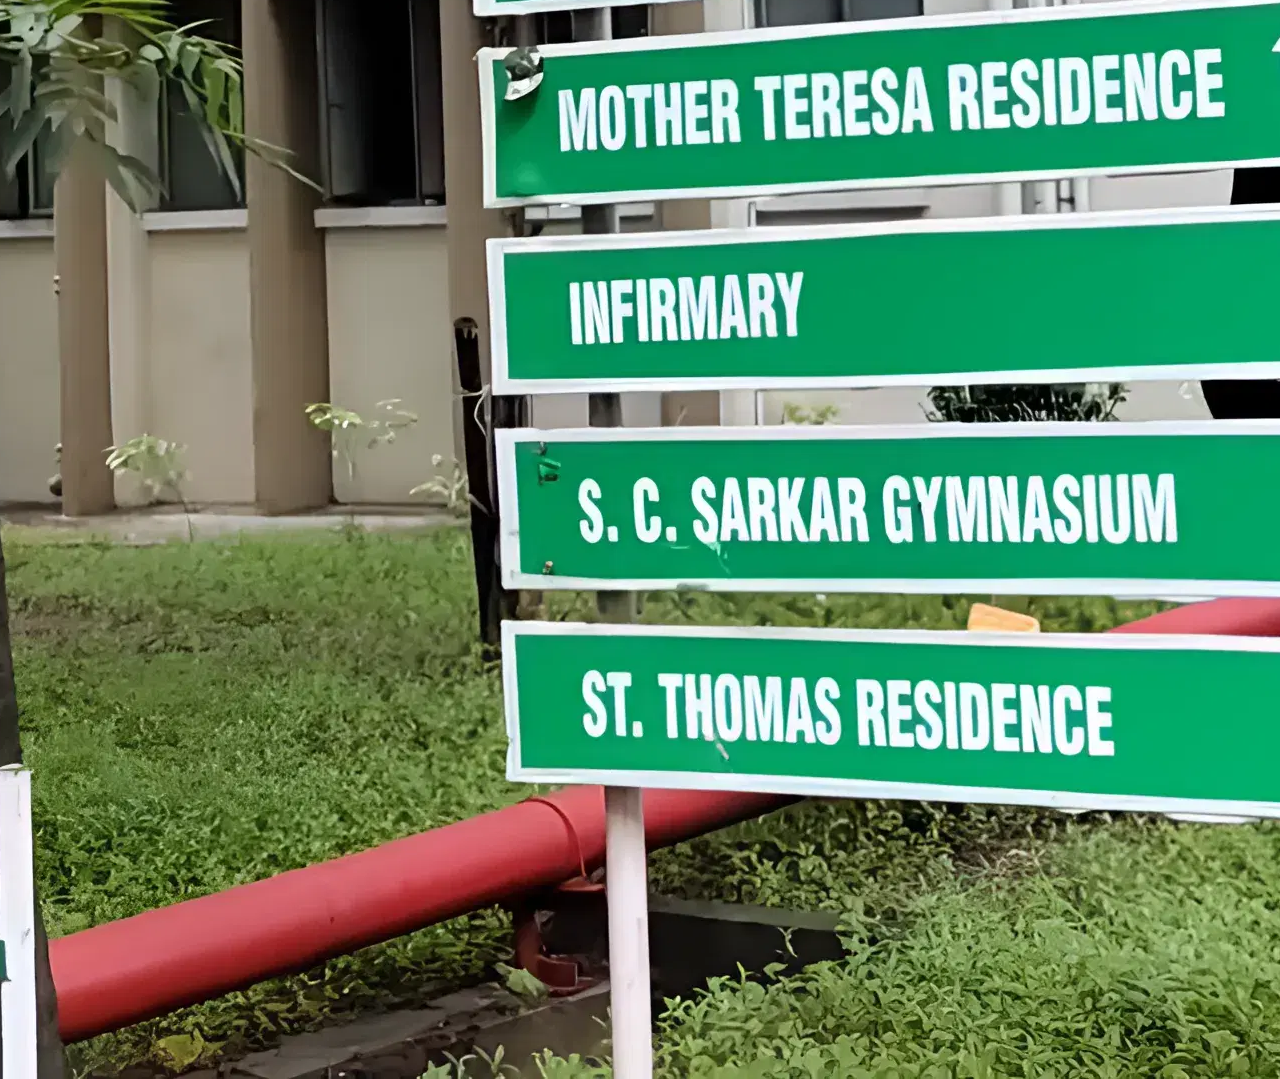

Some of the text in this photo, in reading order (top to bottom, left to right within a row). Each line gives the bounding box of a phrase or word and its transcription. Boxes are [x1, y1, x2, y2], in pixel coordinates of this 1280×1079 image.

[558, 49, 1226, 152] MOTHER TERESA RESIDENCE
[569, 272, 804, 345] INFIRMARY
[578, 474, 1178, 547] S. C. SARKAR GYMNASIUM
[582, 670, 1115, 756] ST. THOMAS RESIDENCE
